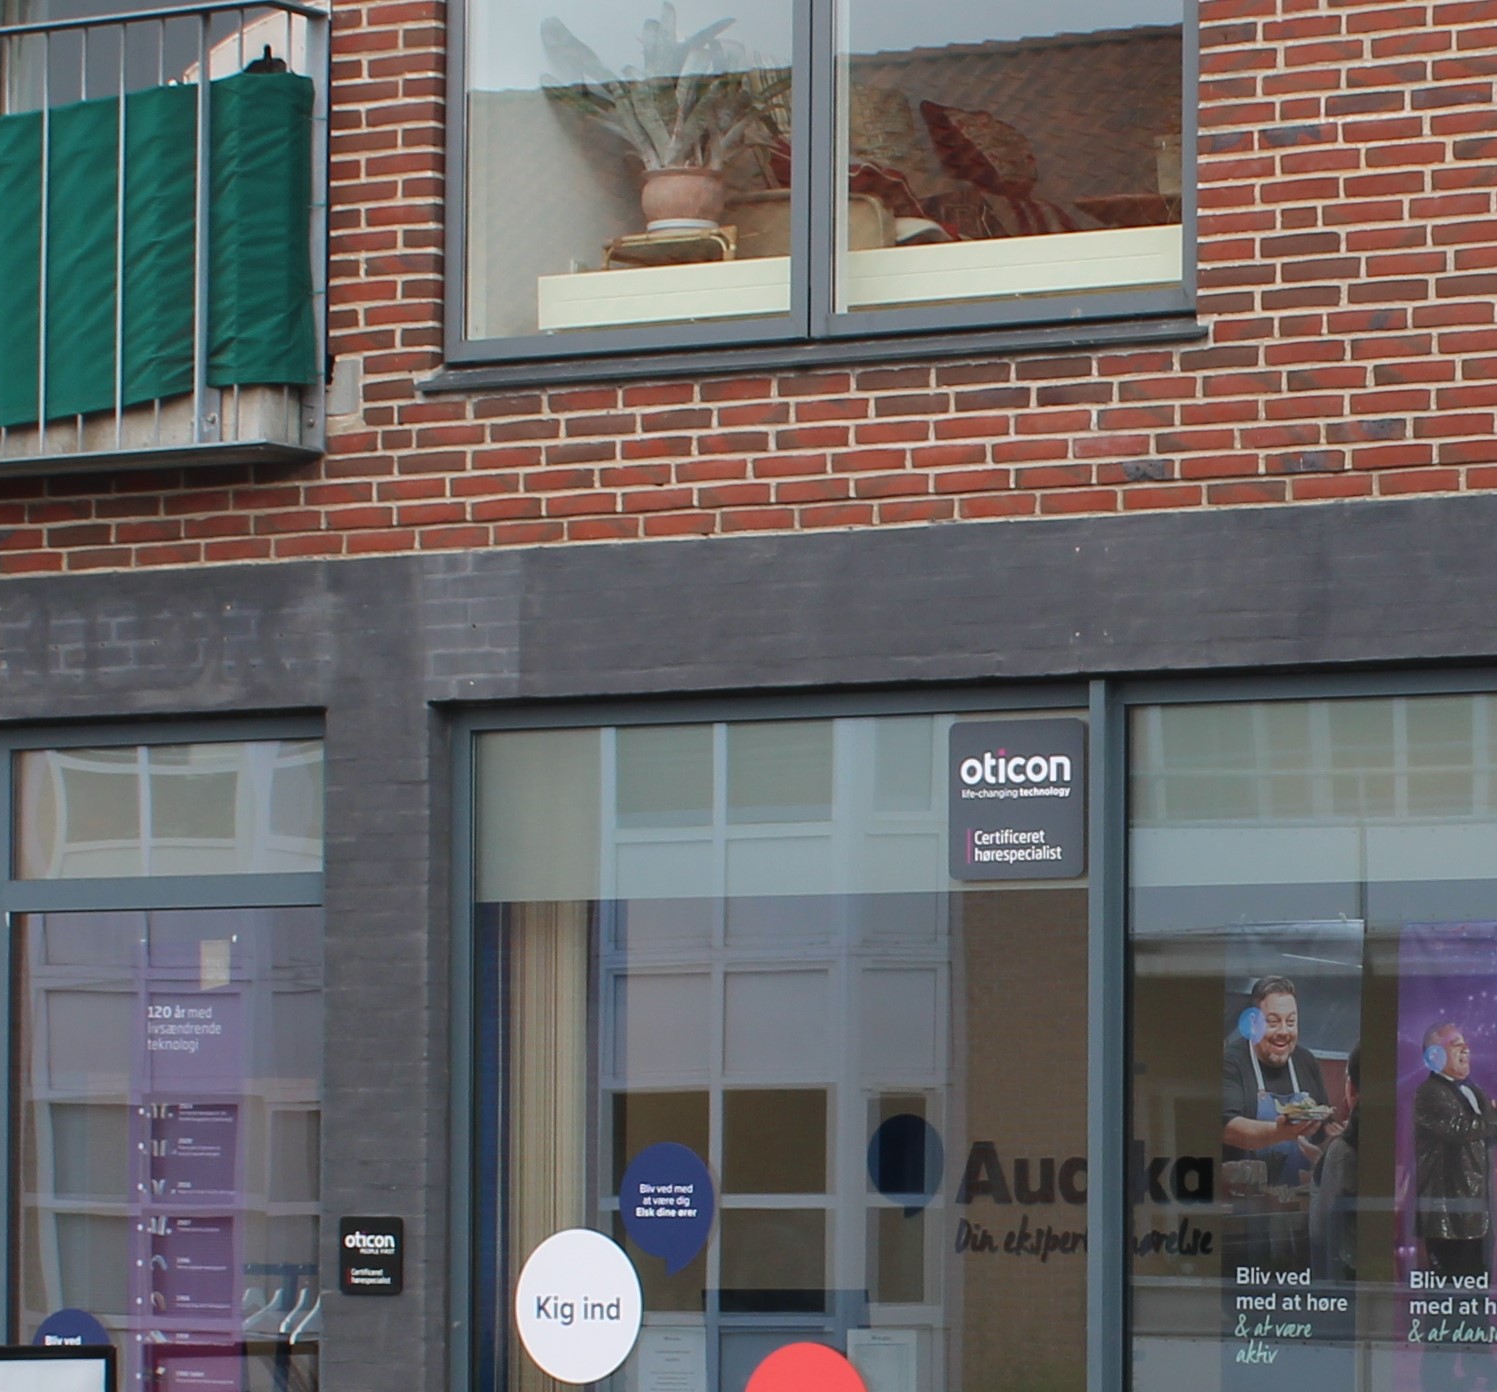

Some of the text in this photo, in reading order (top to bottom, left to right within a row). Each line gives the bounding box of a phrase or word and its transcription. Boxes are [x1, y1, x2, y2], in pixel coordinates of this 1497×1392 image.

[960, 749, 1071, 785] oticon
[962, 787, 1071, 799] life-changing technology
[974, 829, 1045, 845] Certificeret
[974, 846, 1062, 864] hørespecialist
[147, 1005, 213, 1018] 120 år med
[147, 1022, 222, 1035] livsændrende
[147, 1038, 199, 1053] teknologi
[639, 1184, 693, 1193] Bliv ved med
[643, 1197, 690, 1207] at være dig
[635, 1207, 697, 1217] Elsk dine ører
[344, 1231, 395, 1248] oticon
[955, 1216, 998, 1254] Din
[1236, 1267, 1311, 1285] Bliv ved
[1410, 1271, 1488, 1289] Bliv ved
[536, 1296, 621, 1325] Kig ind
[1236, 1293, 1348, 1311] med at høre
[1409, 1297, 1453, 1314] med
[1459, 1298, 1478, 1315] at
[1234, 1313, 1312, 1337] & at være
[1408, 1319, 1424, 1343] &
[1428, 1319, 1450, 1341] at
[64, 1336, 81, 1345] ved
[1236, 1339, 1278, 1364] aktiv
